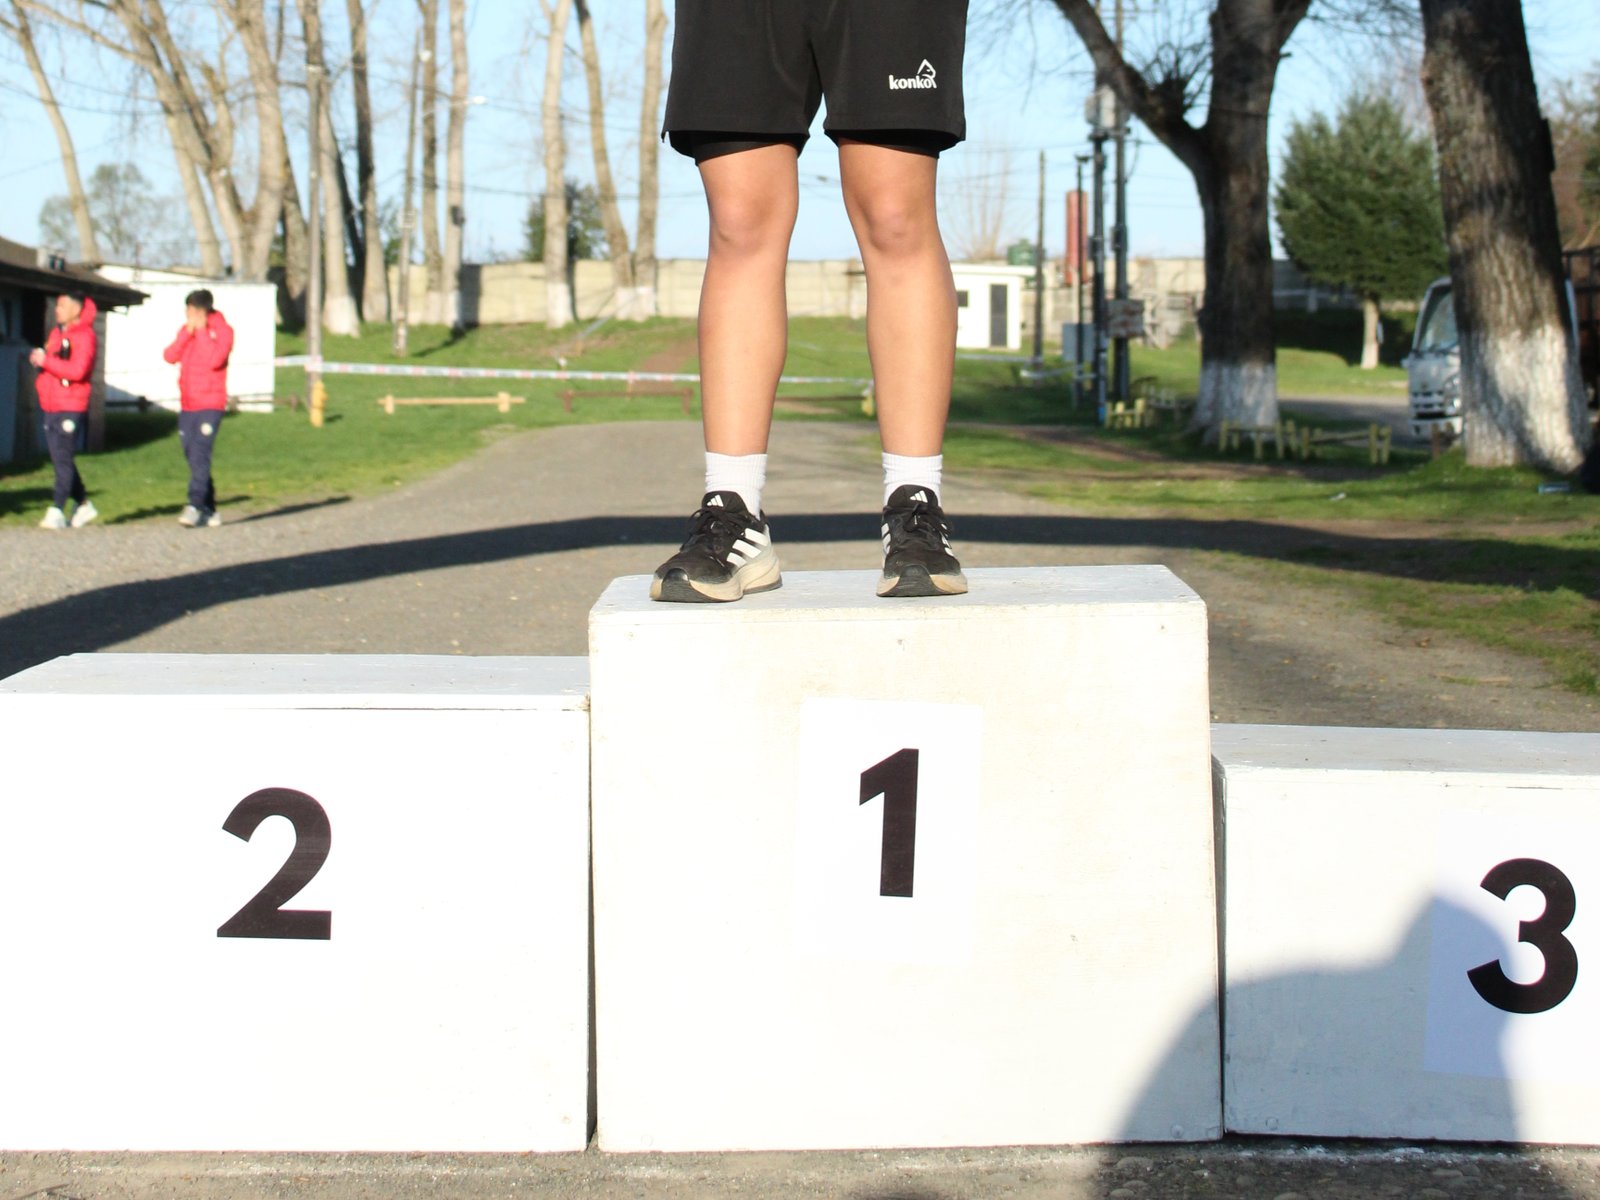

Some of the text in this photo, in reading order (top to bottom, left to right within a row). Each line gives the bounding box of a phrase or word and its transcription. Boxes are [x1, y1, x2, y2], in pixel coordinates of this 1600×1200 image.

[216, 787, 332, 941] 2
[858, 748, 919, 898] 1
[1466, 858, 1578, 1015] 3
